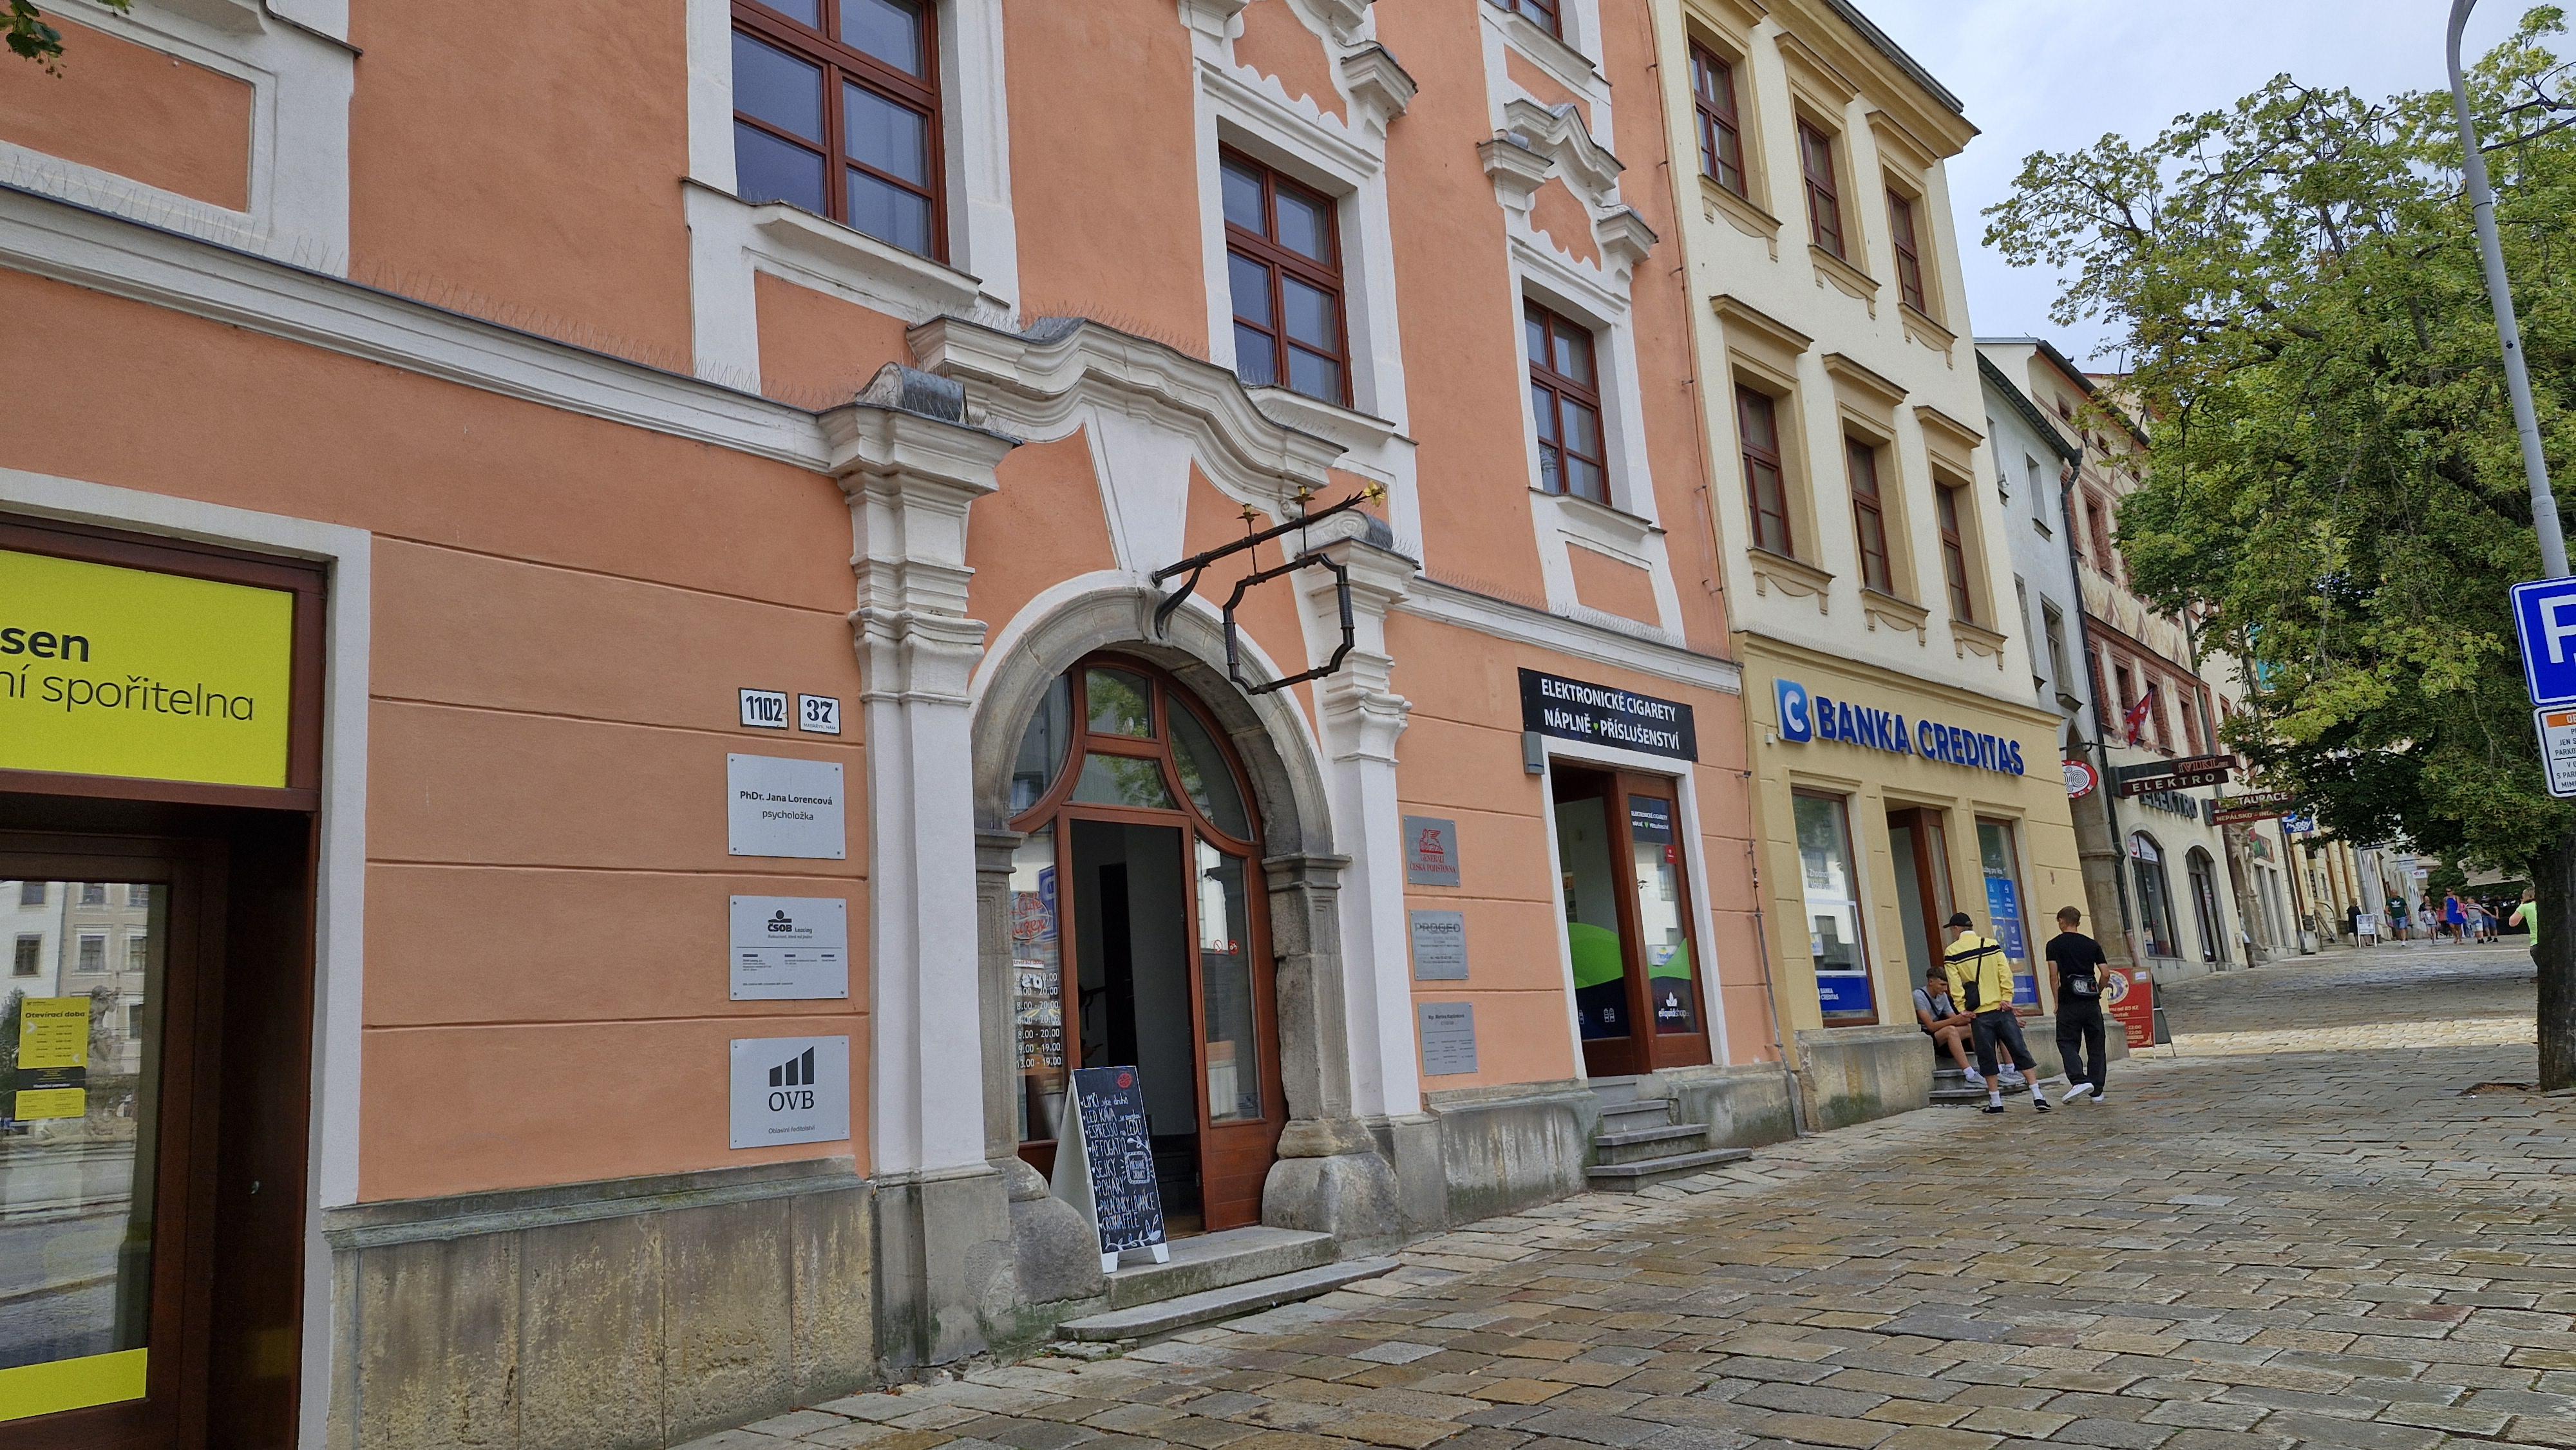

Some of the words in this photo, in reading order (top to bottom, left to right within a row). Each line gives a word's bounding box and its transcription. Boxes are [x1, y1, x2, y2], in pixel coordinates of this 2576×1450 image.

[1, 627, 89, 662] sen
[41, 674, 254, 720] spořitelna
[1541, 678, 1625, 711] ELEKTRONICKÉ
[1626, 697, 1675, 722] CIGARETY
[746, 696, 782, 722] 1102
[806, 699, 833, 723] 37
[1544, 708, 1592, 734] NÁPLNĚ
[1600, 718, 1680, 750] PŘÍSLUŠENSTVÍ
[1812, 695, 1913, 755] BANKA
[1914, 719, 2025, 776] CREDITAS
[2132, 773, 2215, 792] ELEKTRO
[740, 791, 764, 800] PhDr.
[766, 793, 786, 802] Jana
[788, 794, 833, 805] Lorencová
[762, 810, 814, 820] psycholožka
[2216, 813, 2253, 822] NEPÁLSKO
[768, 923, 792, 932] ČSOB
[1017, 1001, 1032, 1010] 8.00
[1039, 1001, 1059, 1010] 20.00
[1018, 1015, 1033, 1024] 8.00
[1018, 1030, 1034, 1039] 8.00
[1041, 1029, 1060, 1038] 20.00
[1018, 1044, 1034, 1053] 9.00
[1042, 1043, 1061, 1052] 19.00
[1017, 1059, 1035, 1068] 13.00
[1043, 1057, 1061, 1067] 19.00
[768, 1090, 815, 1111] OVB
[1088, 1122, 1119, 1138] ESPRESSO
[1126, 1119, 1142, 1136] LEDU
[1091, 1136, 1127, 1157] AFFOGATO
[1094, 1158, 1117, 1178] ŠEJKY
[1097, 1174, 1125, 1196] POHÁRY
